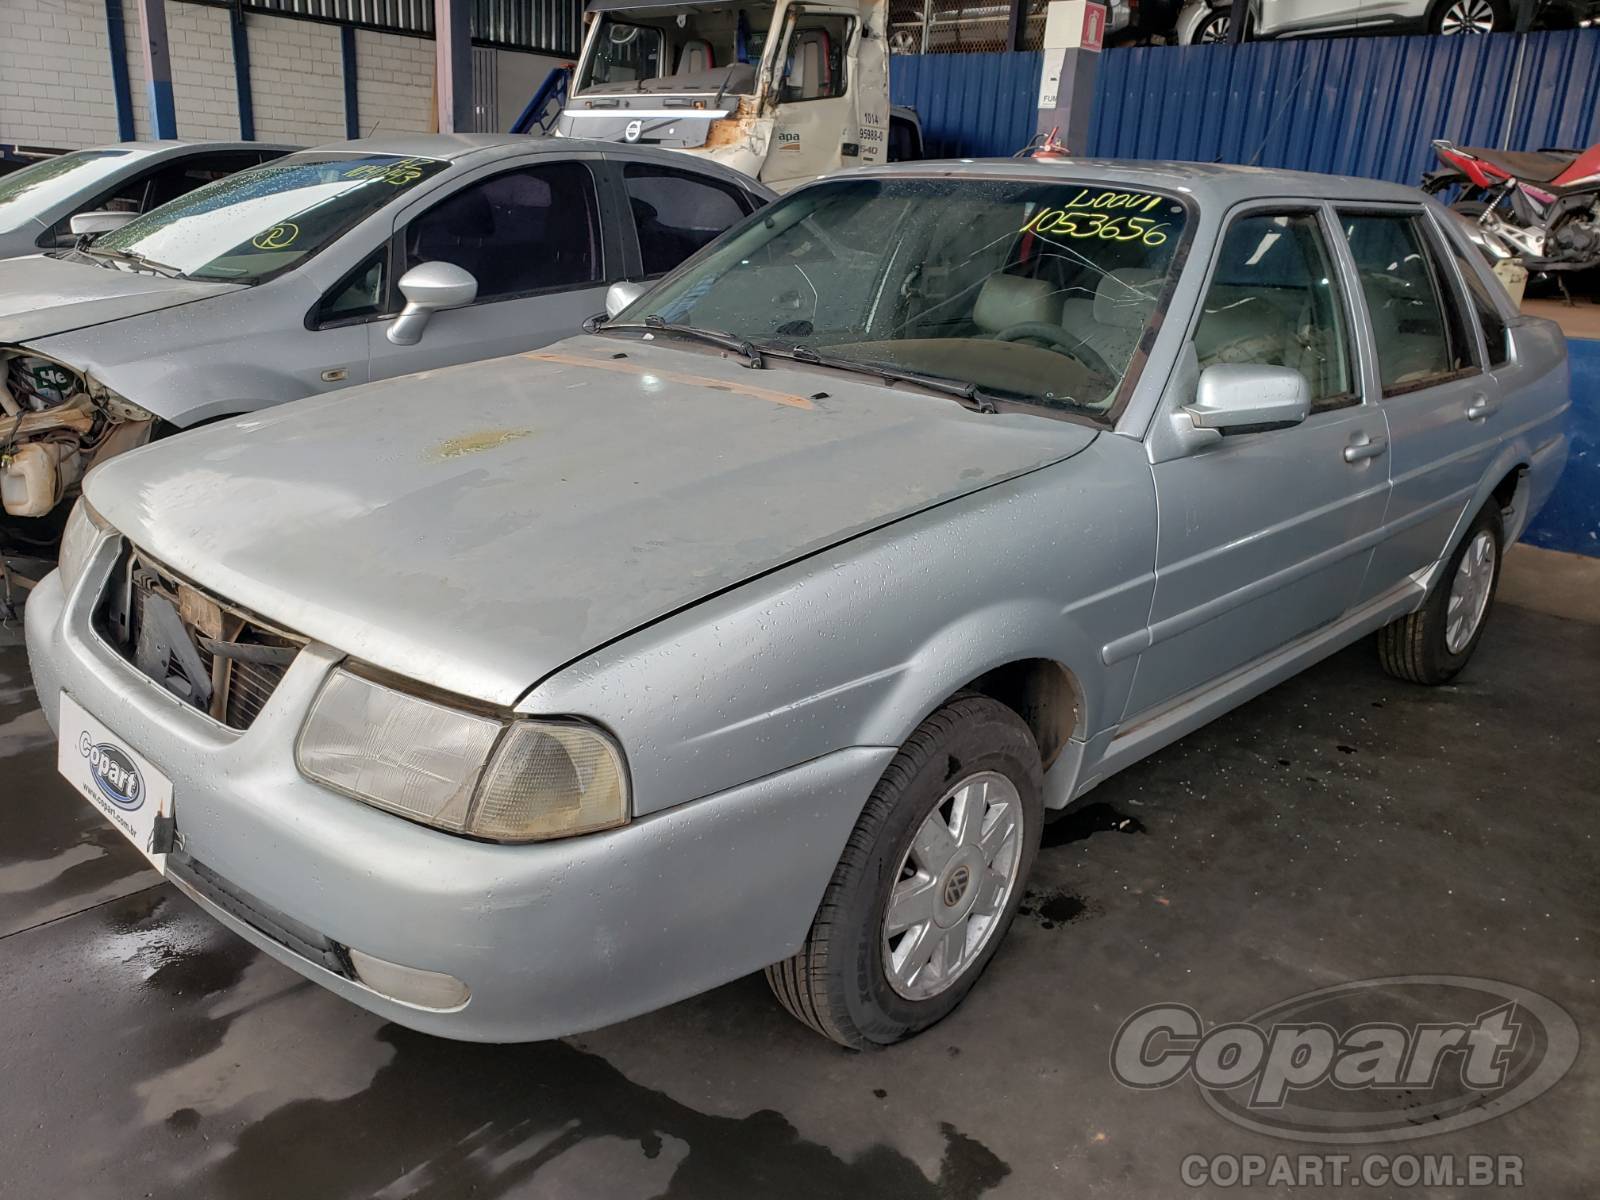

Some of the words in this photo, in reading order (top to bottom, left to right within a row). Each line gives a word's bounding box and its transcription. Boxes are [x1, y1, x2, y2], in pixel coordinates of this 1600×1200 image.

[864, 112, 879, 125] 1014
[1019, 207, 1172, 246] 1053656
[79, 730, 138, 799] Copart
[83, 782, 137, 838] www.copart.com.br
